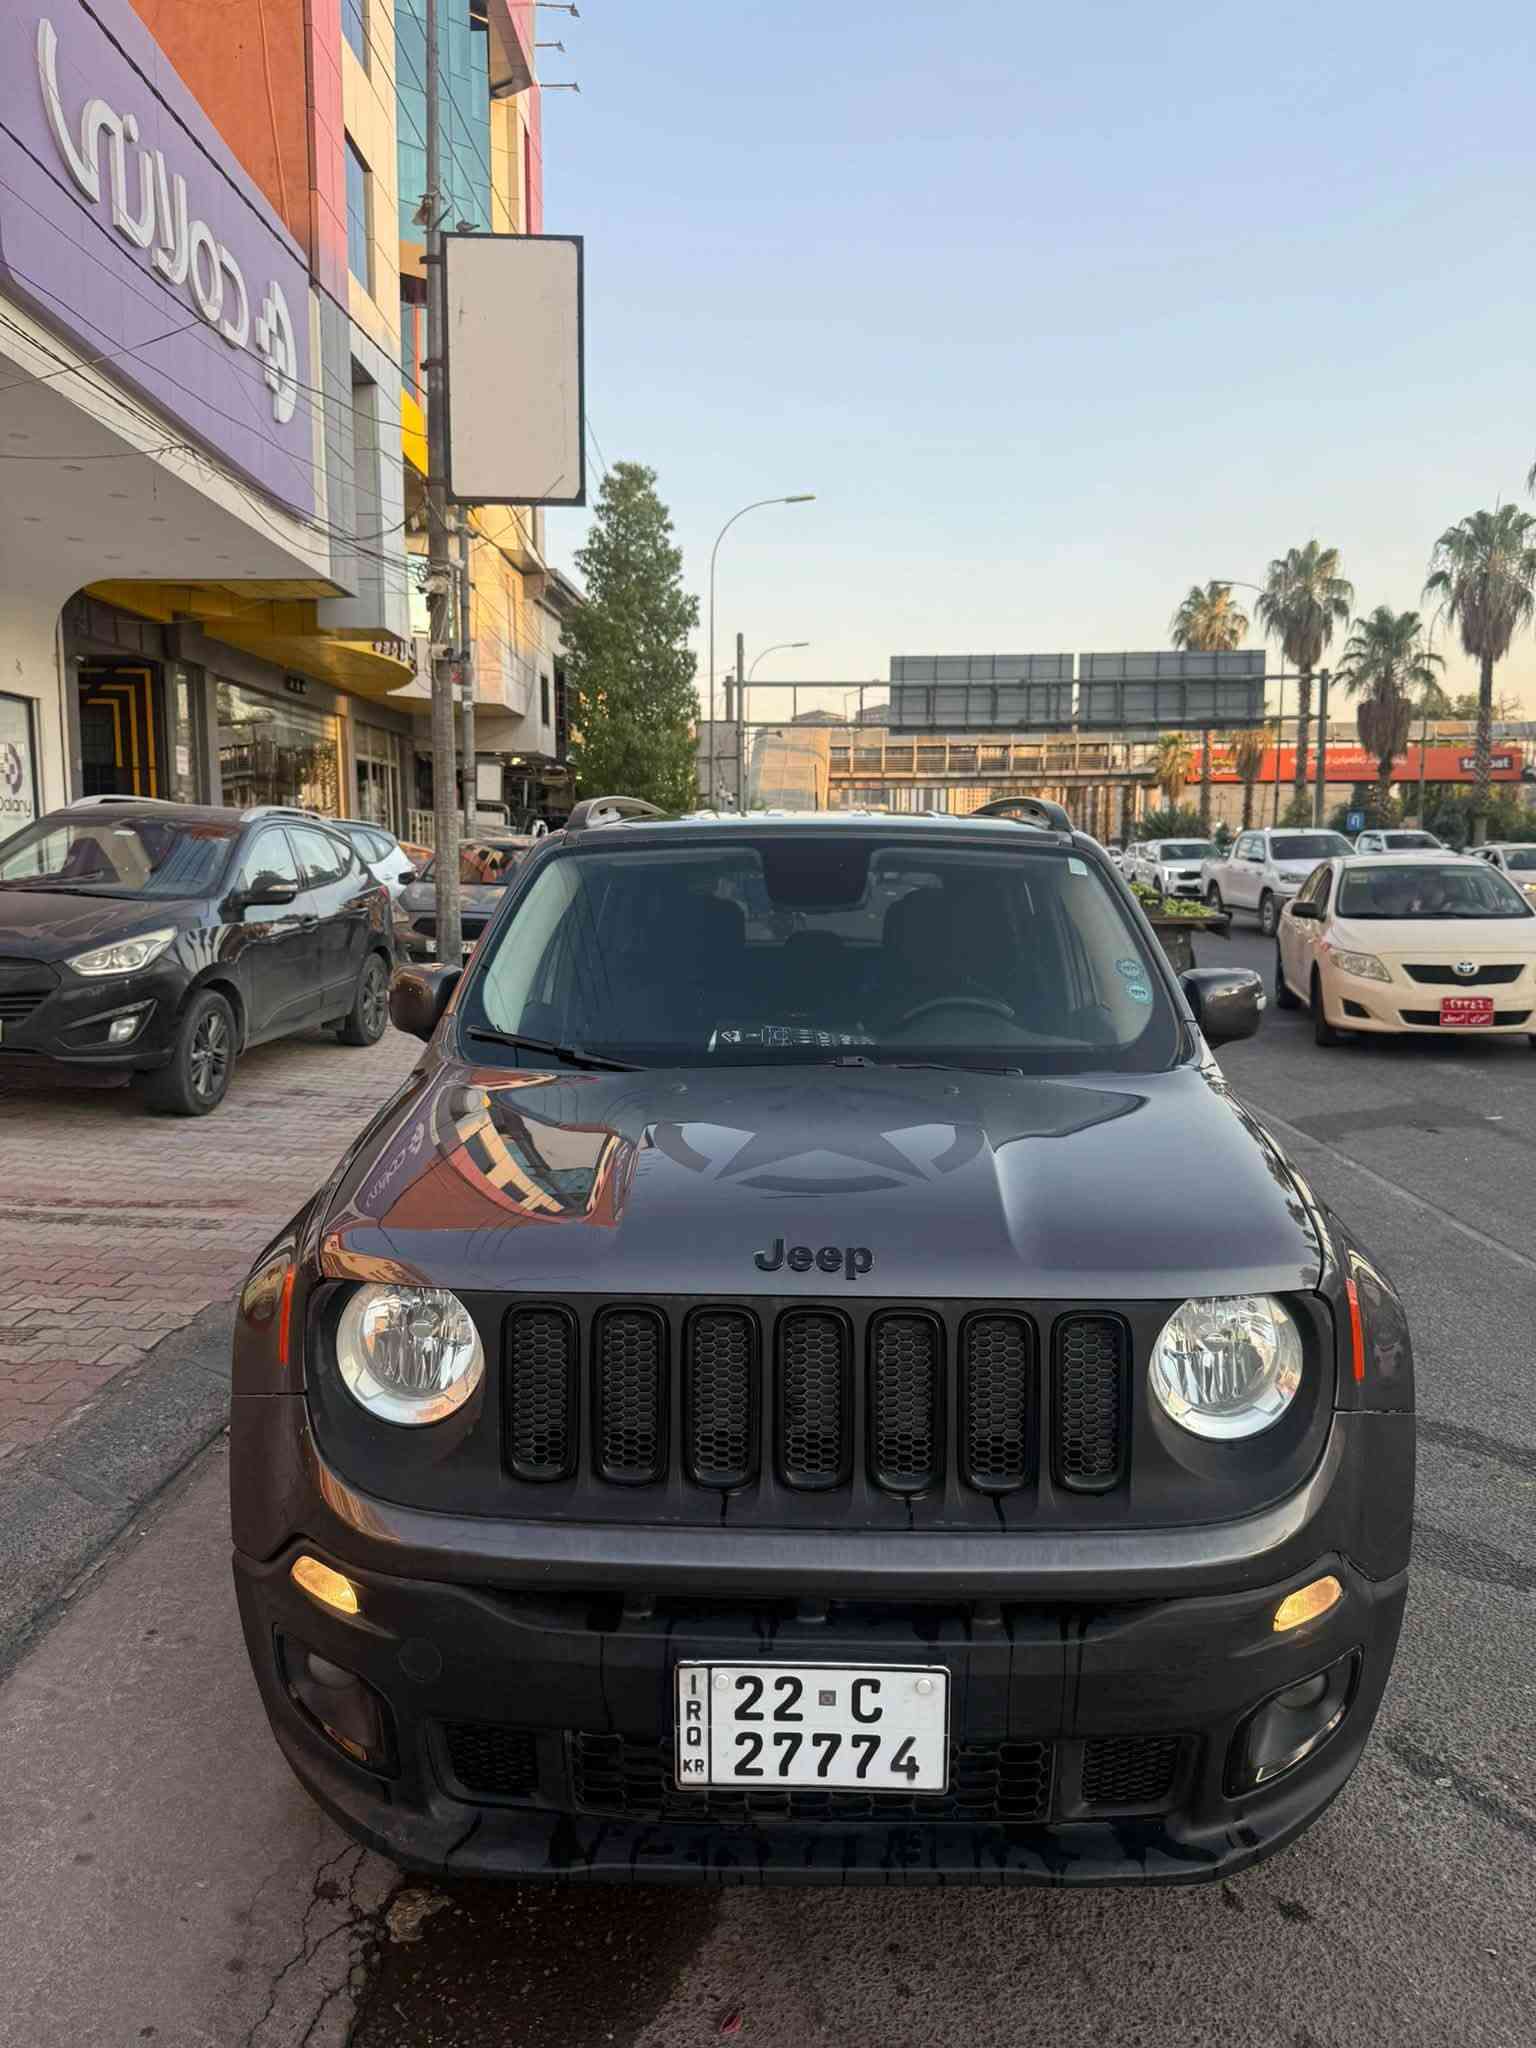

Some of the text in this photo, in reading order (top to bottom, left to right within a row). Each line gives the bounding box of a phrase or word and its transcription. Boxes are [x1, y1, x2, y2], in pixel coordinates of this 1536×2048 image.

[753, 1238, 873, 1281] Jeep
[686, 1674, 702, 1747] IRQ
[734, 1675, 884, 1723] 22 C
[683, 1759, 705, 1773] KR
[734, 1731, 920, 1781] 27774
